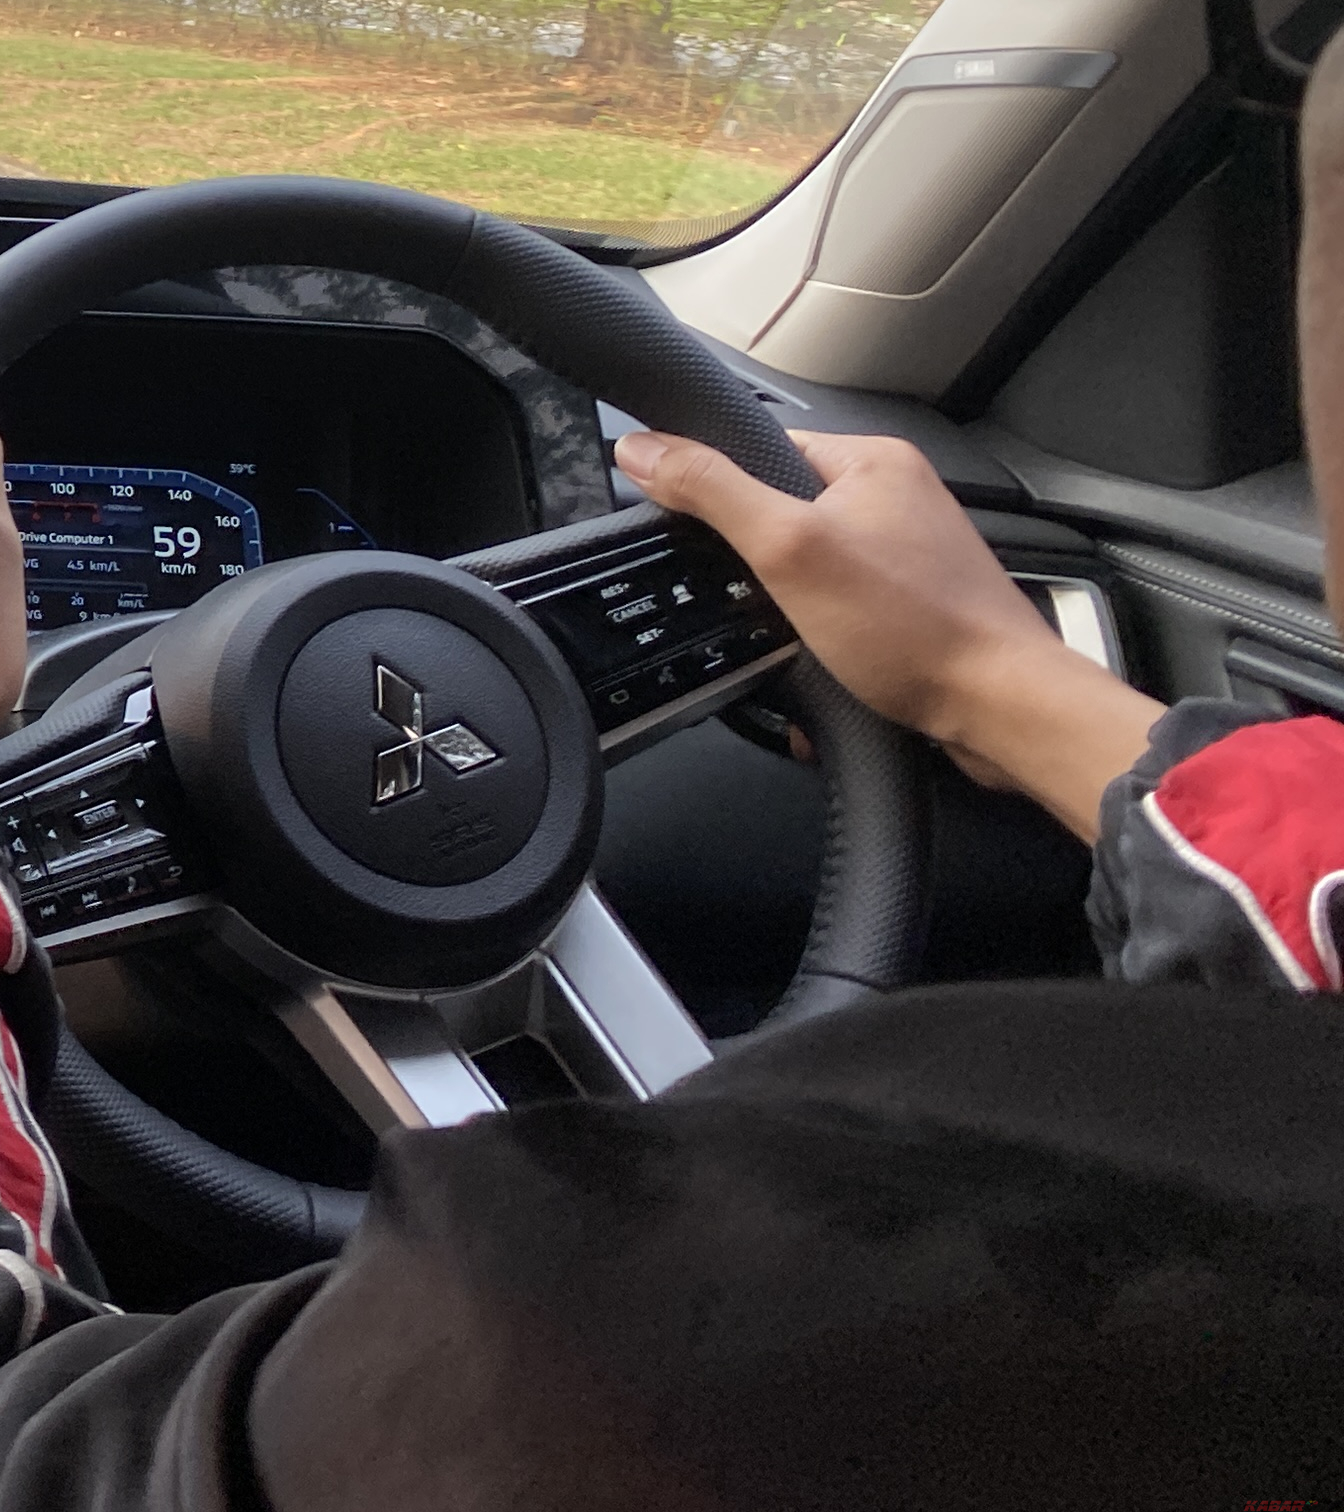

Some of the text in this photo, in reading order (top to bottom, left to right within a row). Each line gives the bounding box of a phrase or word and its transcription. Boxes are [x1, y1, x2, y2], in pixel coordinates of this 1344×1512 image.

[50, 482, 76, 495] 100
[110, 484, 134, 497] 120
[167, 489, 192, 501] 140
[215, 515, 241, 528] 160
[18, 532, 114, 545] Drive Computer 1
[153, 525, 201, 558] 59
[24, 558, 120, 572] VG 4.5 km/L
[161, 562, 196, 576] km/h
[219, 564, 245, 576] 180
[70, 596, 85, 606] 20
[26, 610, 42, 620] VG
[83, 806, 117, 825] ENTER
